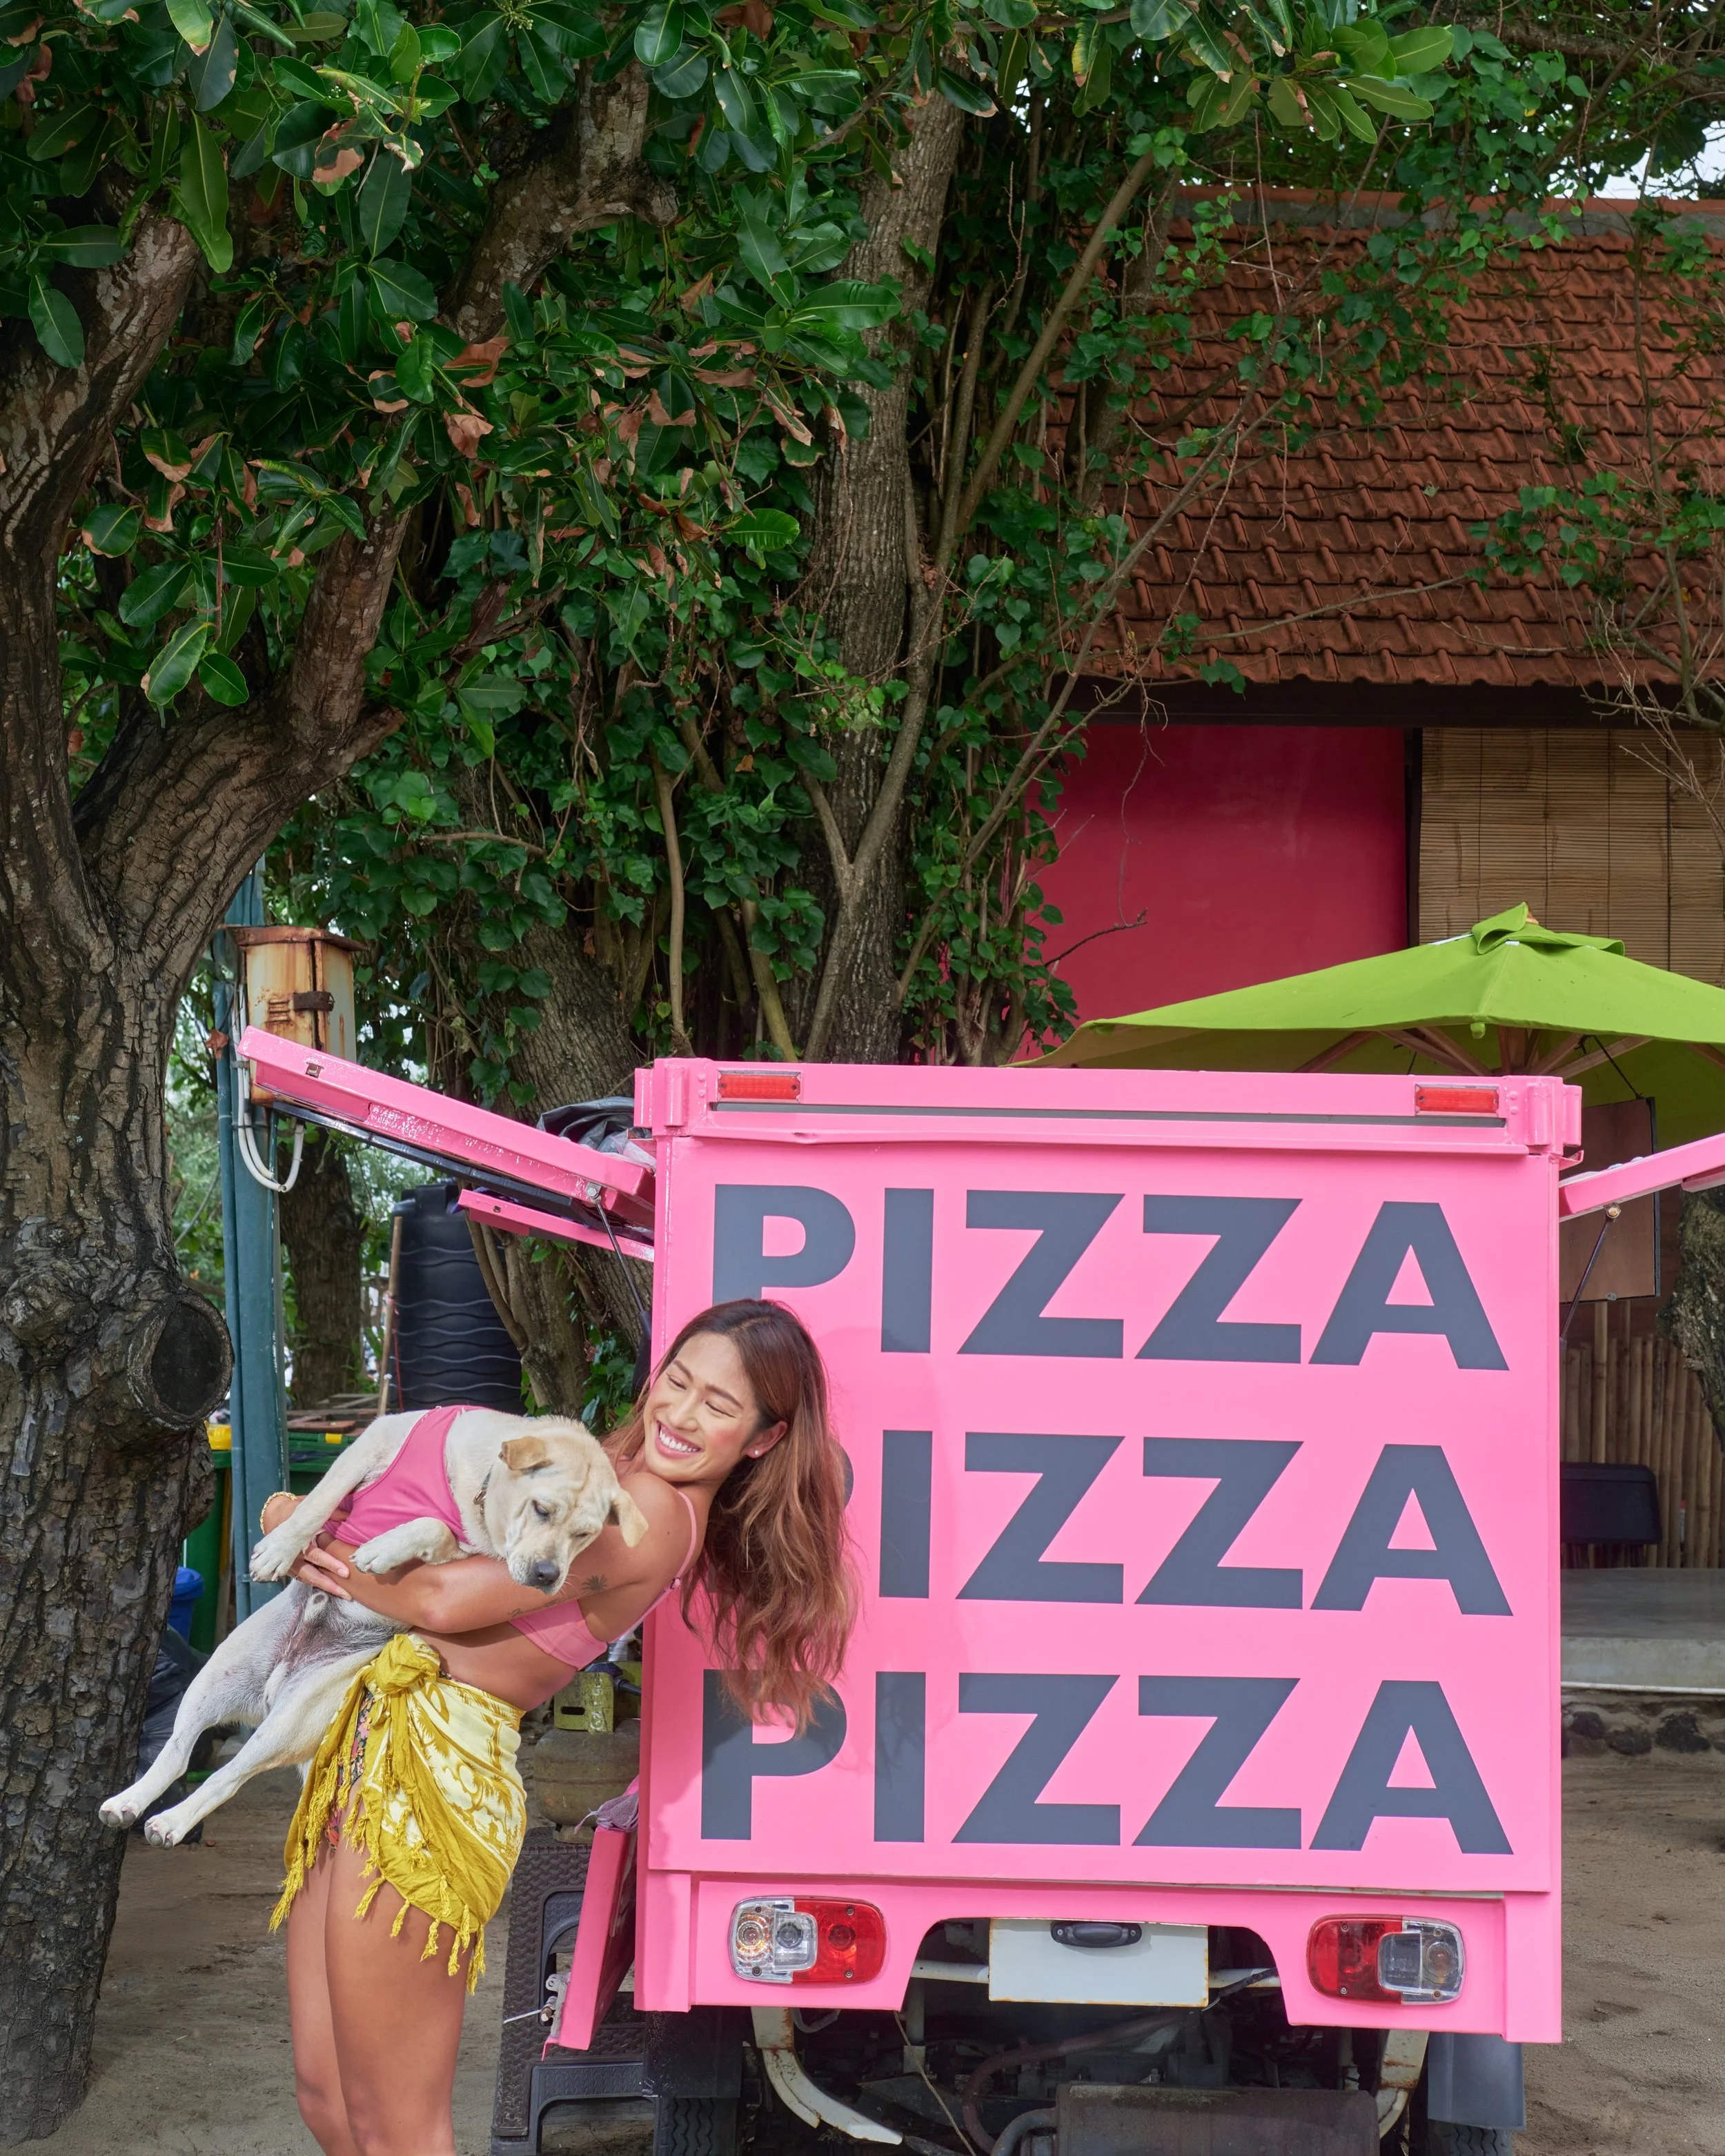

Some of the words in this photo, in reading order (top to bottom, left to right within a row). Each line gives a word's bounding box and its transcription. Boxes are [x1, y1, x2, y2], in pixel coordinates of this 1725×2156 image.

[713, 1184, 1509, 1371] PIZZA
[709, 1430, 1512, 1616] IZZA
[701, 1668, 1513, 1855] PIZZA
